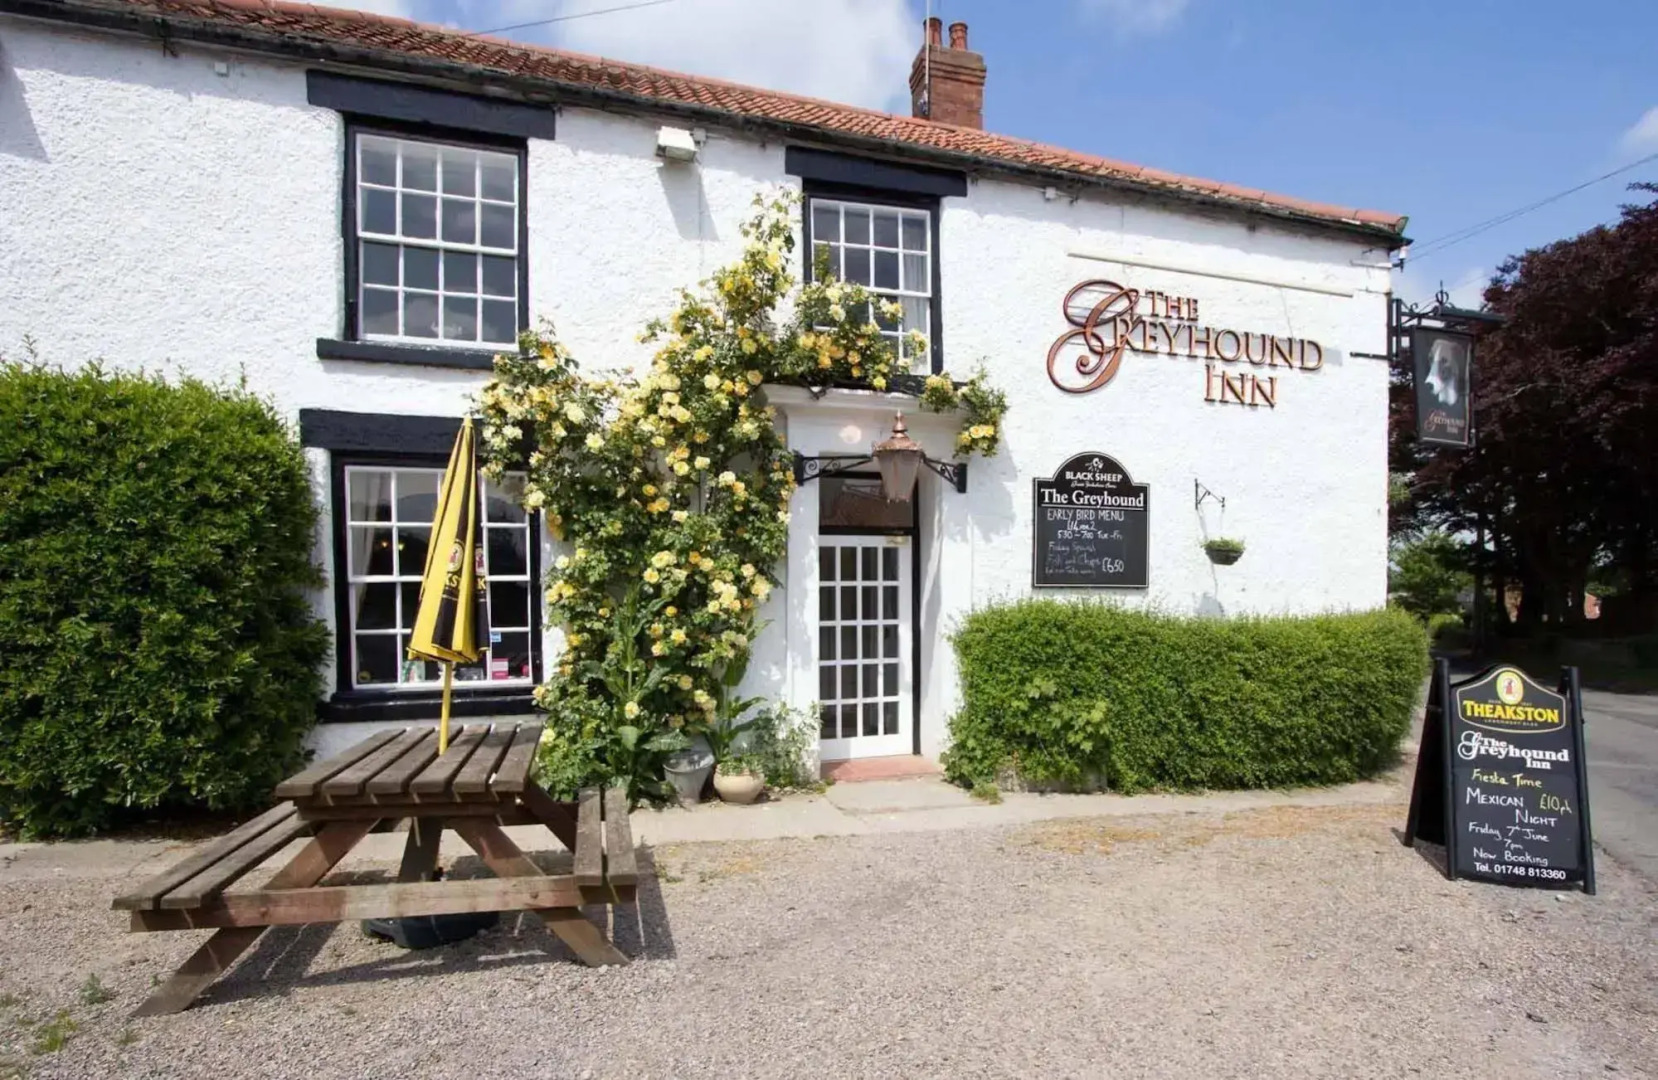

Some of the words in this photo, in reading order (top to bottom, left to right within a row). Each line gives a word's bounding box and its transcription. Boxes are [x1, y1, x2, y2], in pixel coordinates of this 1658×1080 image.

[1145, 289, 1199, 321] THE
[1047, 279, 1323, 393] GREYHOUND
[1203, 363, 1277, 408] INN
[1065, 471, 1094, 481] BLACK
[1095, 472, 1123, 483] SHEEP
[1040, 488, 1069, 503] The
[1072, 489, 1144, 508] Greyhound
[1047, 508, 1073, 521] EARLY
[1076, 509, 1095, 521] BIRD
[1098, 509, 1125, 522] MENU
[1462, 700, 1560, 724] THEAKSTON
[1457, 730, 1570, 762] Greyhound
[1480, 736, 1508, 748] The
[1525, 758, 1552, 770] Inn
[1471, 768, 1509, 785] Fiesta
[1512, 773, 1543, 788] Time
[1466, 786, 1524, 807] MEXICAN
[1468, 821, 1502, 841] Friday
[1521, 828, 1549, 842] June
[1503, 839, 1523, 851] 7pm
[1473, 847, 1496, 860] Now
[1504, 850, 1548, 867] Booking
[1494, 864, 1526, 876] 01748
[1527, 867, 1567, 880] 813360
